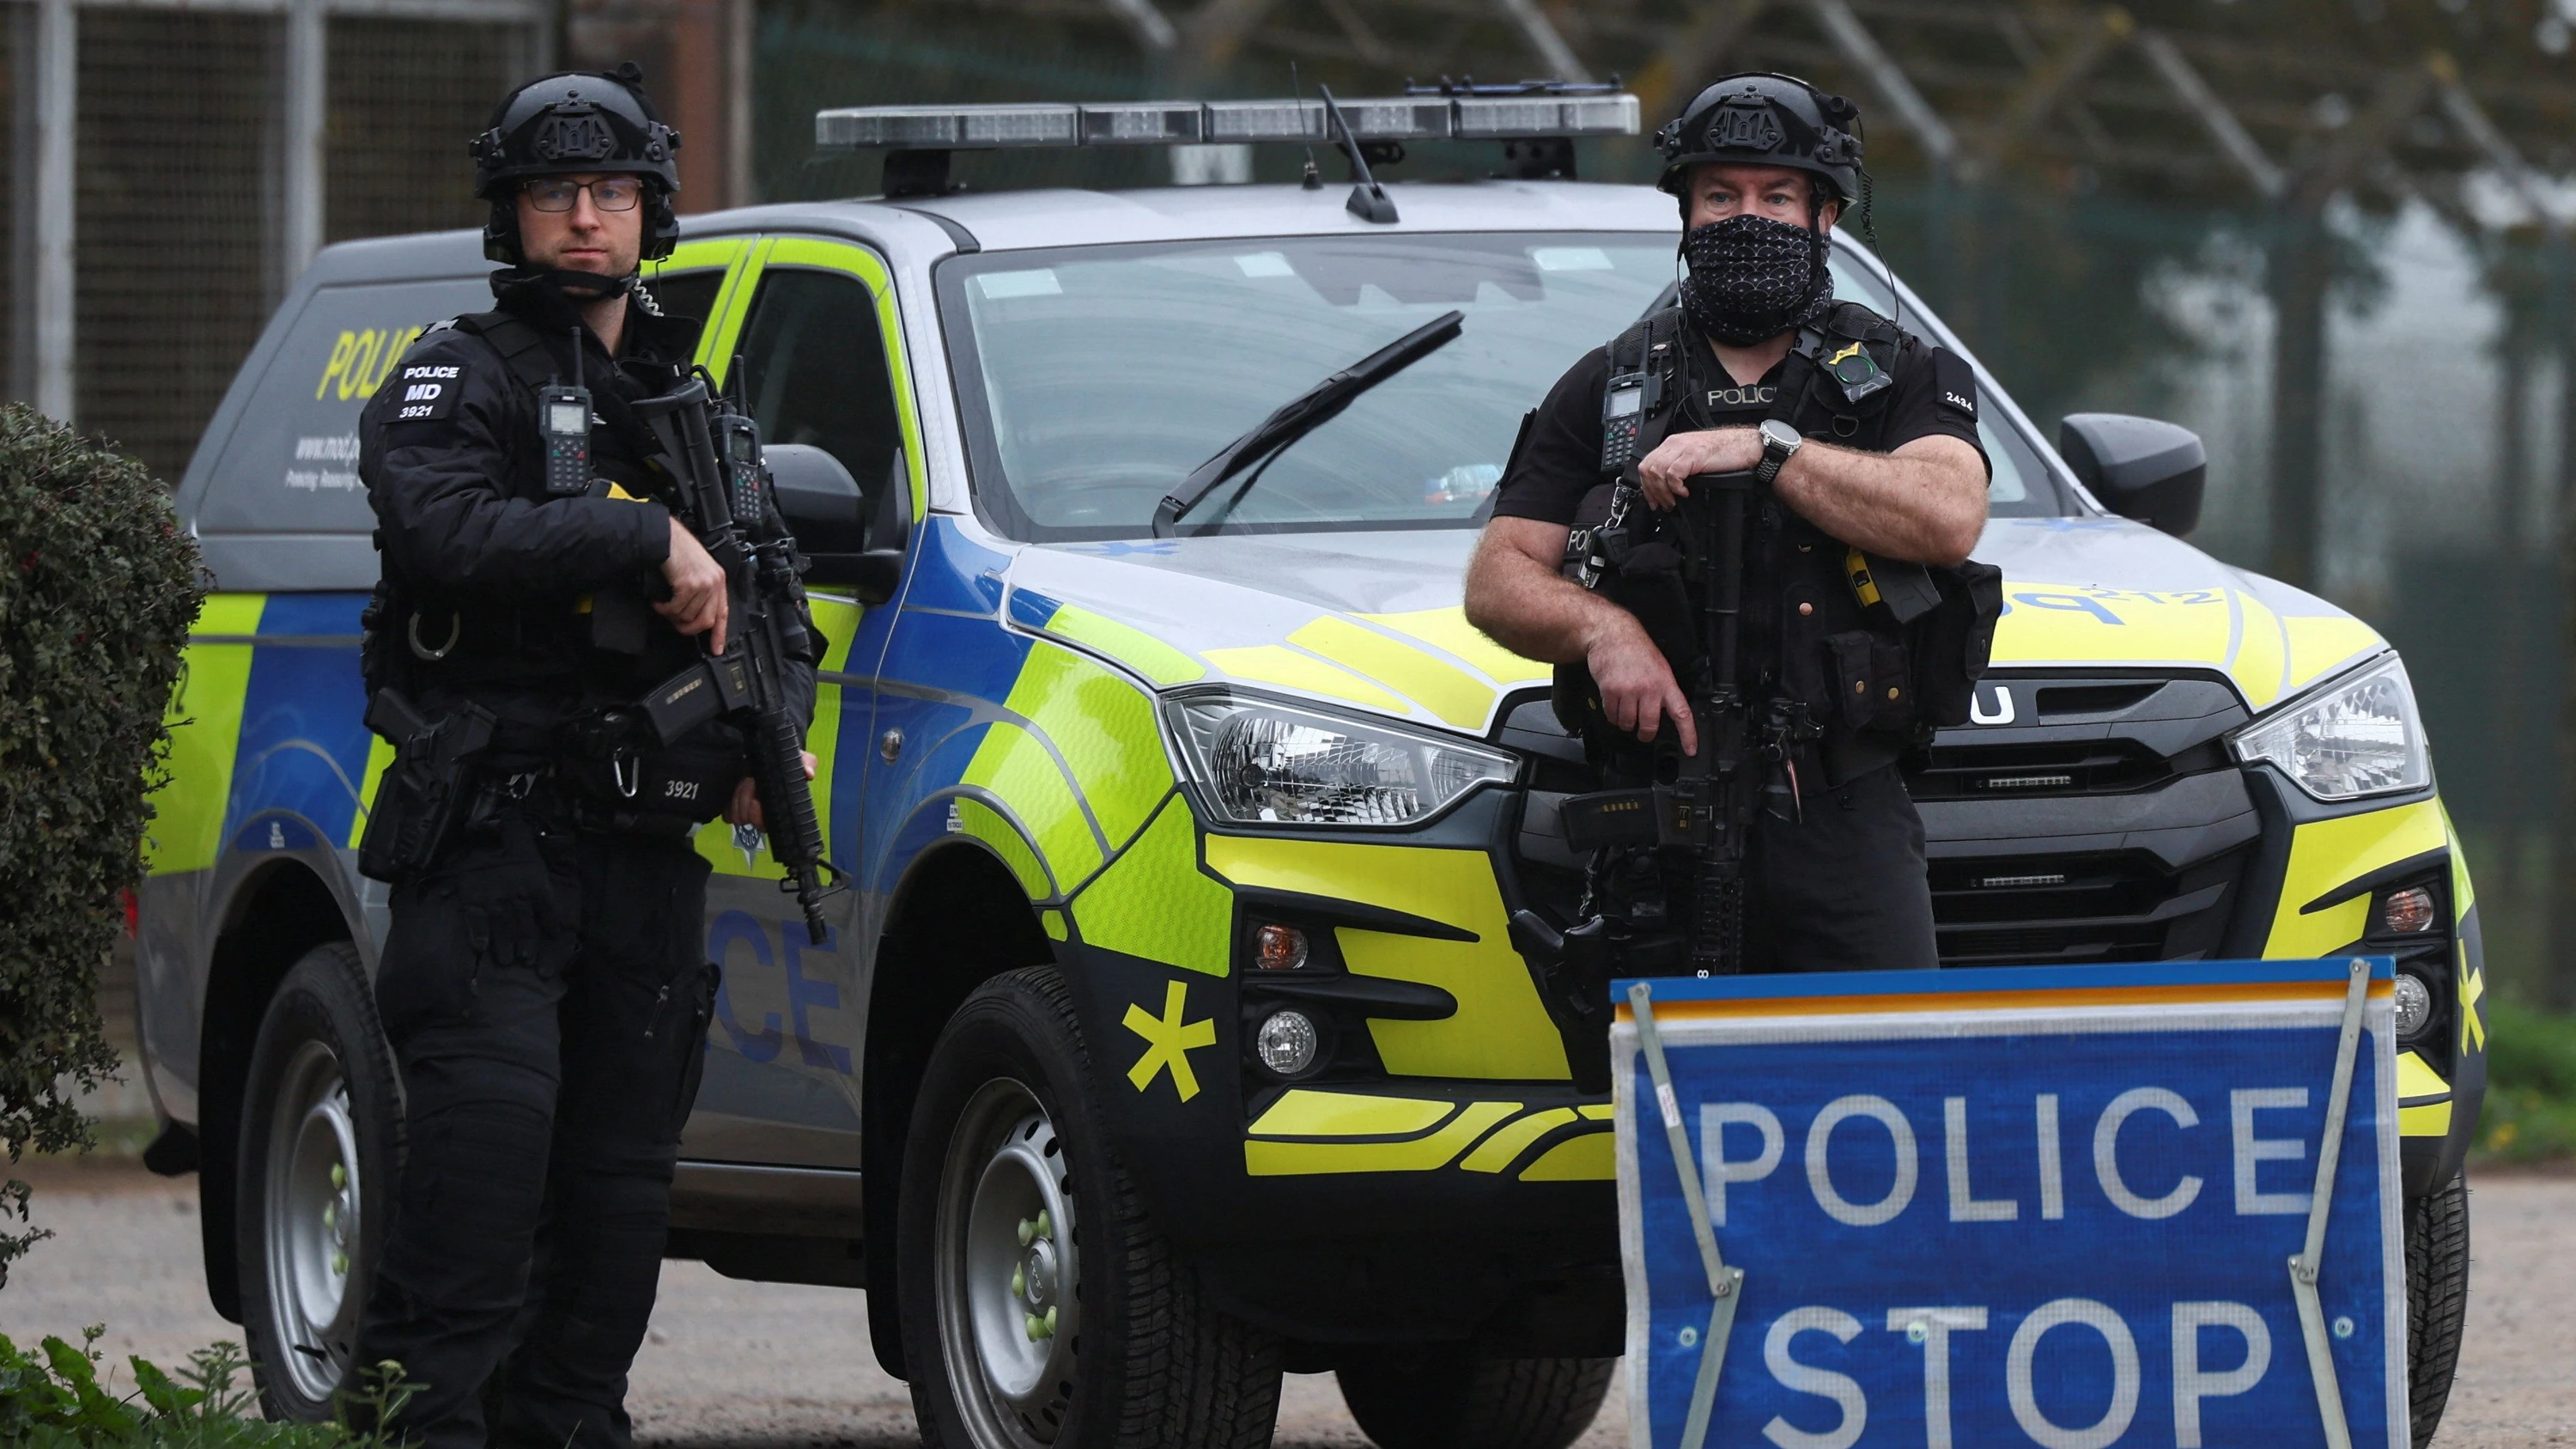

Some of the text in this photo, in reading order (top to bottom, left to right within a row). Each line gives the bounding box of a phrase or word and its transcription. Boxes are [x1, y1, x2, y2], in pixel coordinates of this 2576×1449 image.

[404, 366, 459, 379] POLICE
[404, 383, 442, 402] MD
[1707, 387, 1777, 405] POLIC
[1946, 391, 1973, 411] 2434
[399, 405, 434, 418] 3921
[665, 780, 700, 800] 3921
[706, 910, 853, 1075] CE
[1700, 1086, 2313, 1227] POLICE
[1761, 1298, 2272, 1449] STOP
